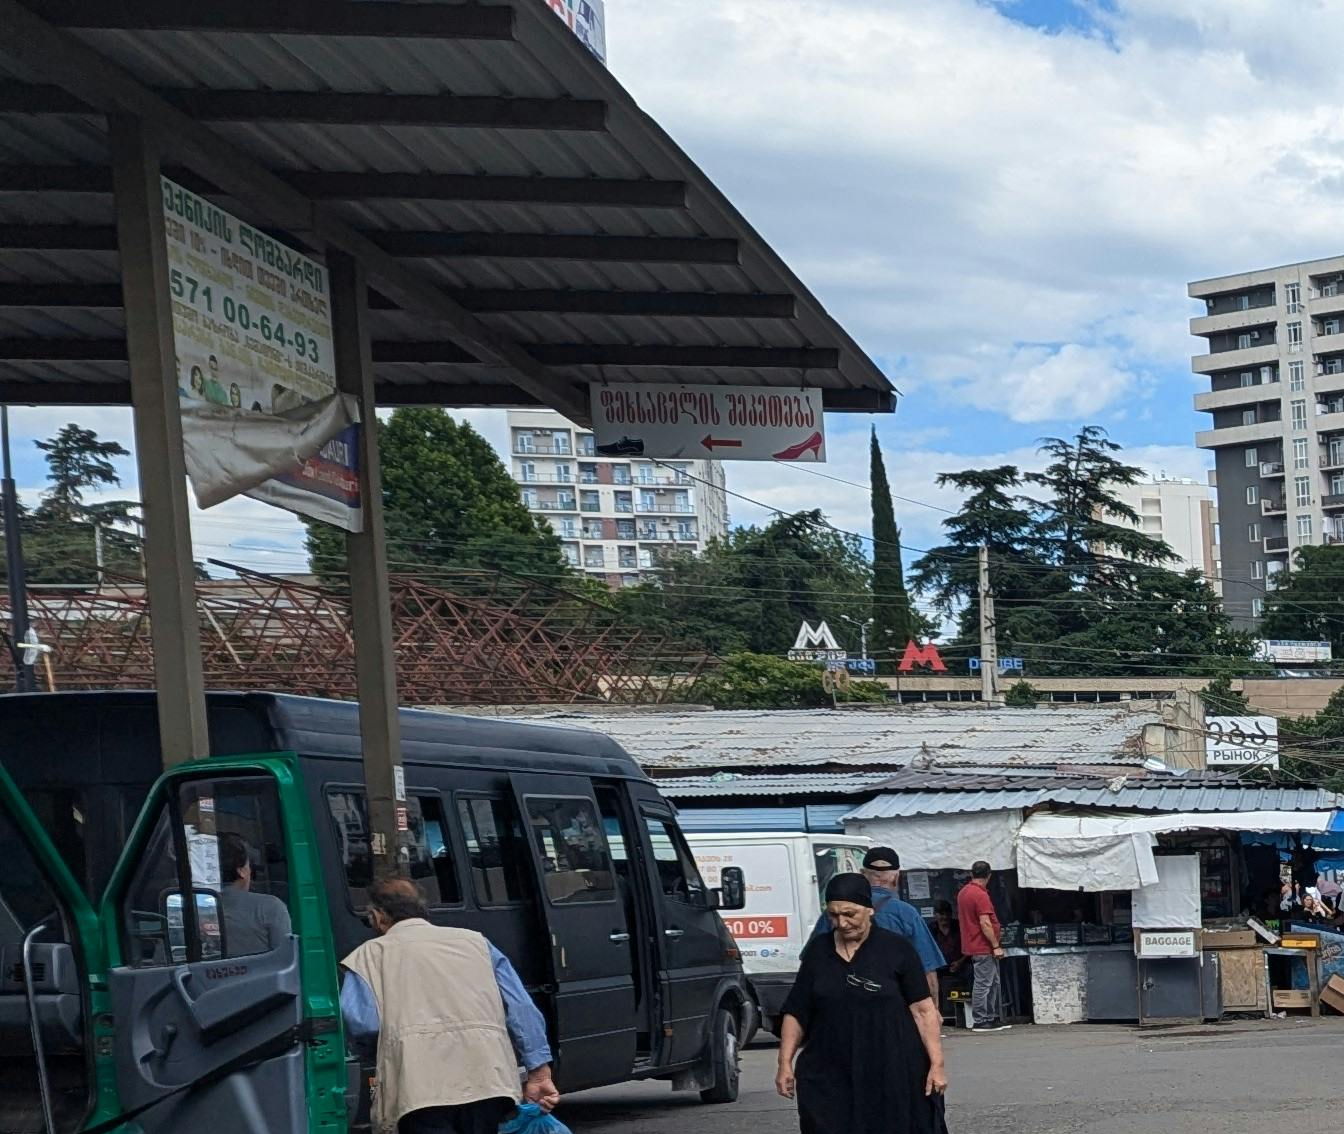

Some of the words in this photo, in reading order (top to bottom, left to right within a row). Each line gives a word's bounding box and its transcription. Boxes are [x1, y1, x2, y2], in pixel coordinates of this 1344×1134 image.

[164, 181, 232, 244] ექნიკის
[170, 268, 213, 313] 571
[223, 296, 320, 363] 00-64-93
[725, 393, 815, 428] შეკეთება
[969, 658, 1024, 670] DUBE
[1213, 750, 1260, 761] РЫНОК
[748, 920, 774, 934] 0%
[1145, 937, 1191, 946] BAGGAGE
